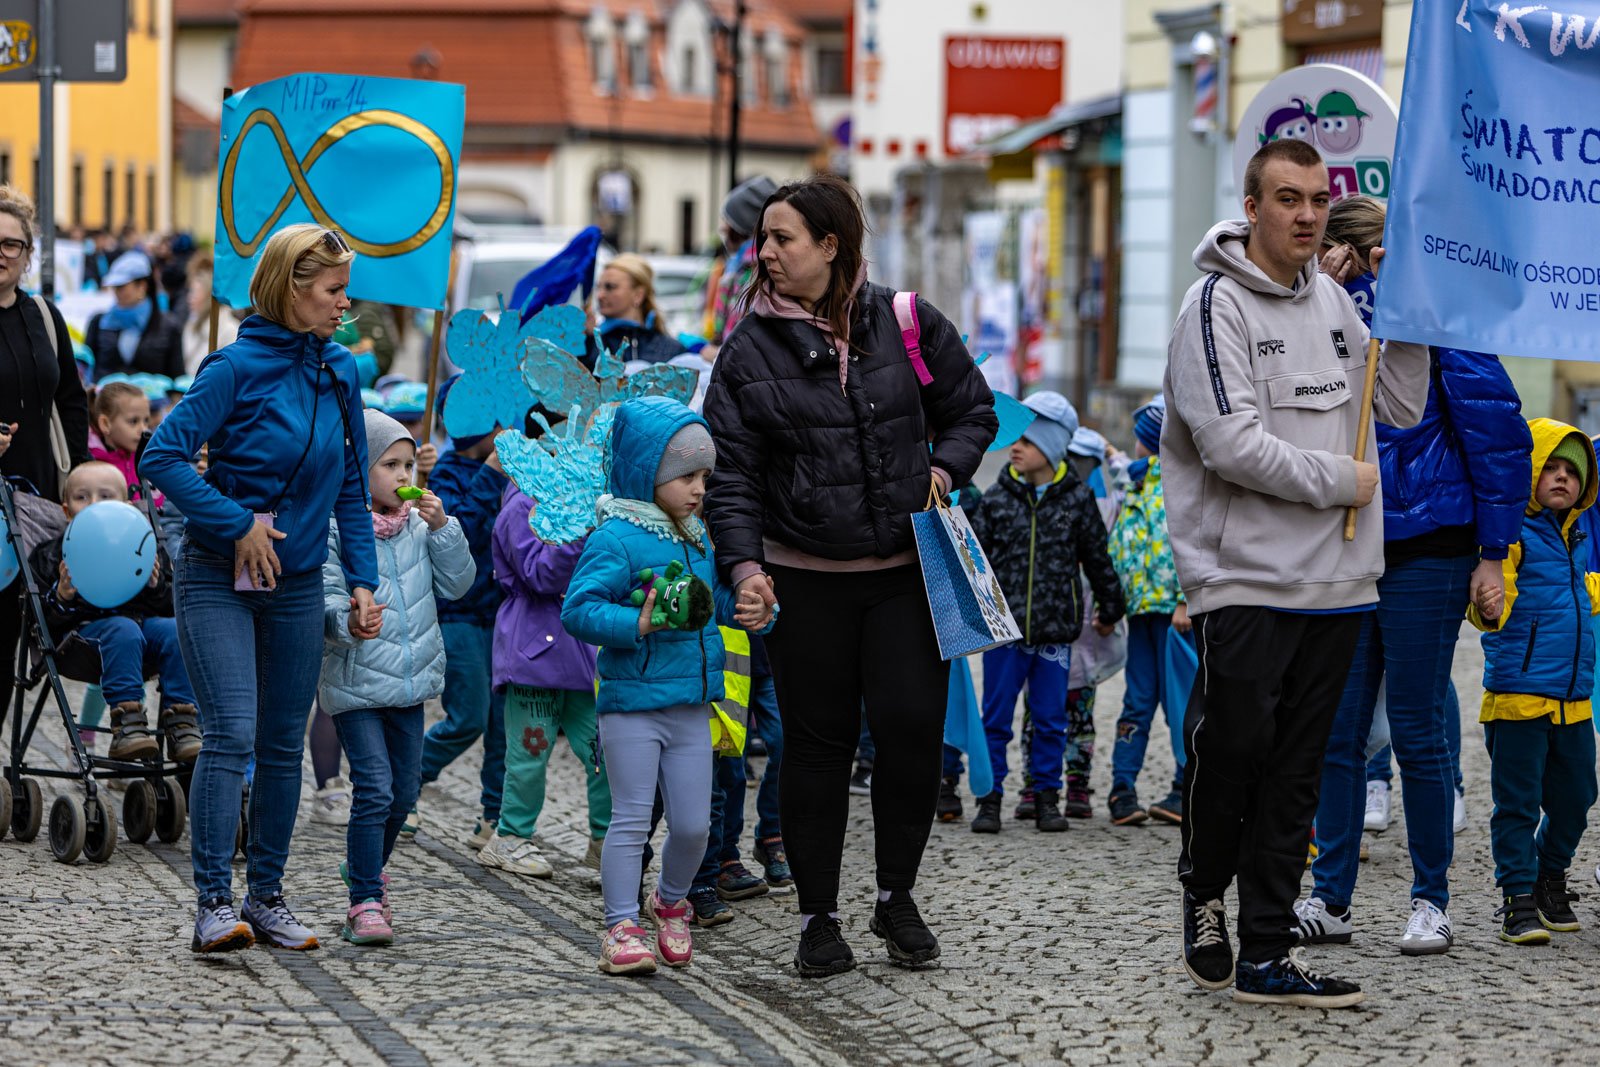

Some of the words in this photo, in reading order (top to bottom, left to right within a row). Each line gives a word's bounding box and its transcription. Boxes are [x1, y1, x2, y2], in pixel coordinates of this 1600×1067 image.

[281, 76, 327, 113] MIP
[345, 78, 367, 112] 14
[1424, 234, 1519, 278] SPECJALNY
[1524, 261, 1600, 286] OŚROD
[1550, 291, 1569, 310] W
[1575, 293, 1600, 311] JE
[1258, 344, 1285, 357] NYC
[1295, 380, 1346, 396] BROOKLYN
